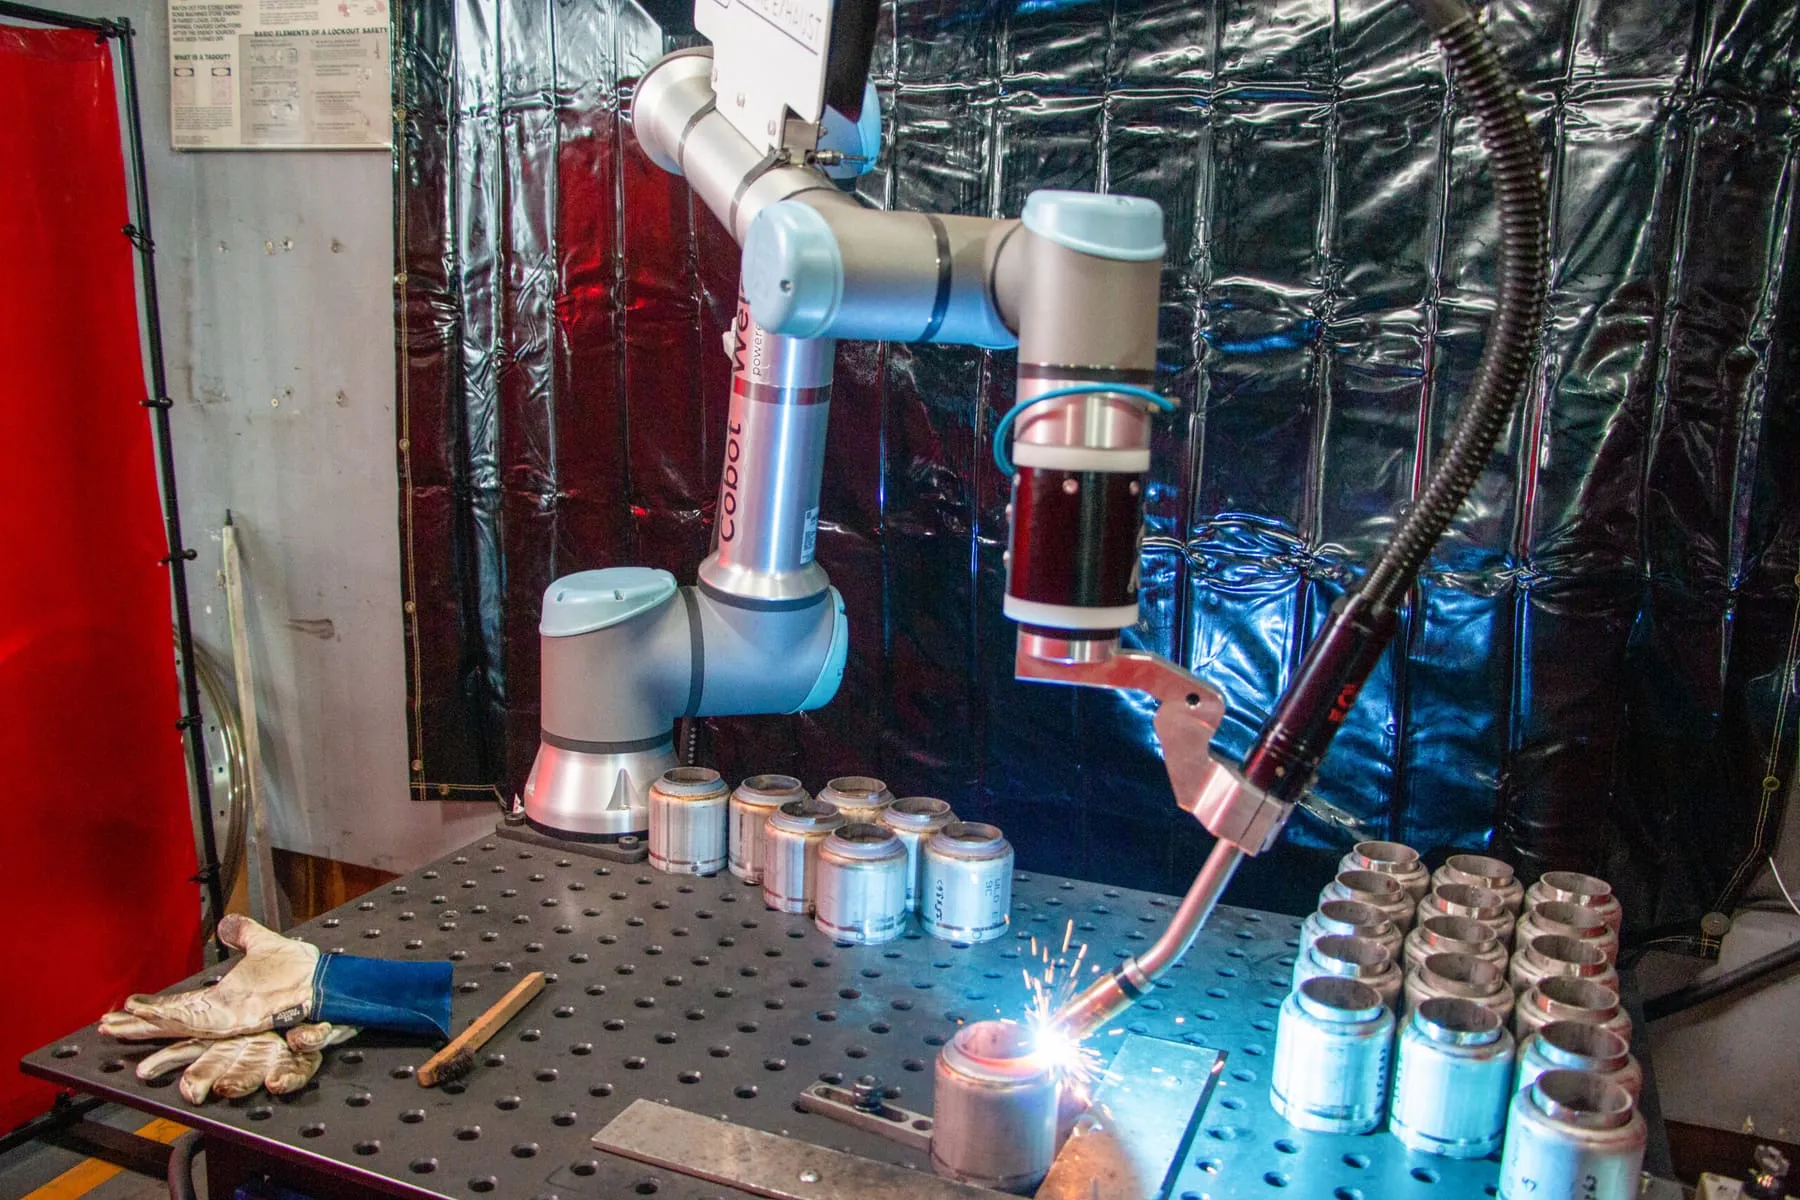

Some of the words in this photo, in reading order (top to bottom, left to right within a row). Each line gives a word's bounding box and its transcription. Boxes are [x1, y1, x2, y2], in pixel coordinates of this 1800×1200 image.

[275, 29, 310, 37] ELEMENTS
[327, 28, 360, 36] LOCKOUT
[752, 323, 763, 377] powere
[720, 420, 741, 542] Cobot
[732, 276, 751, 373] Wel
